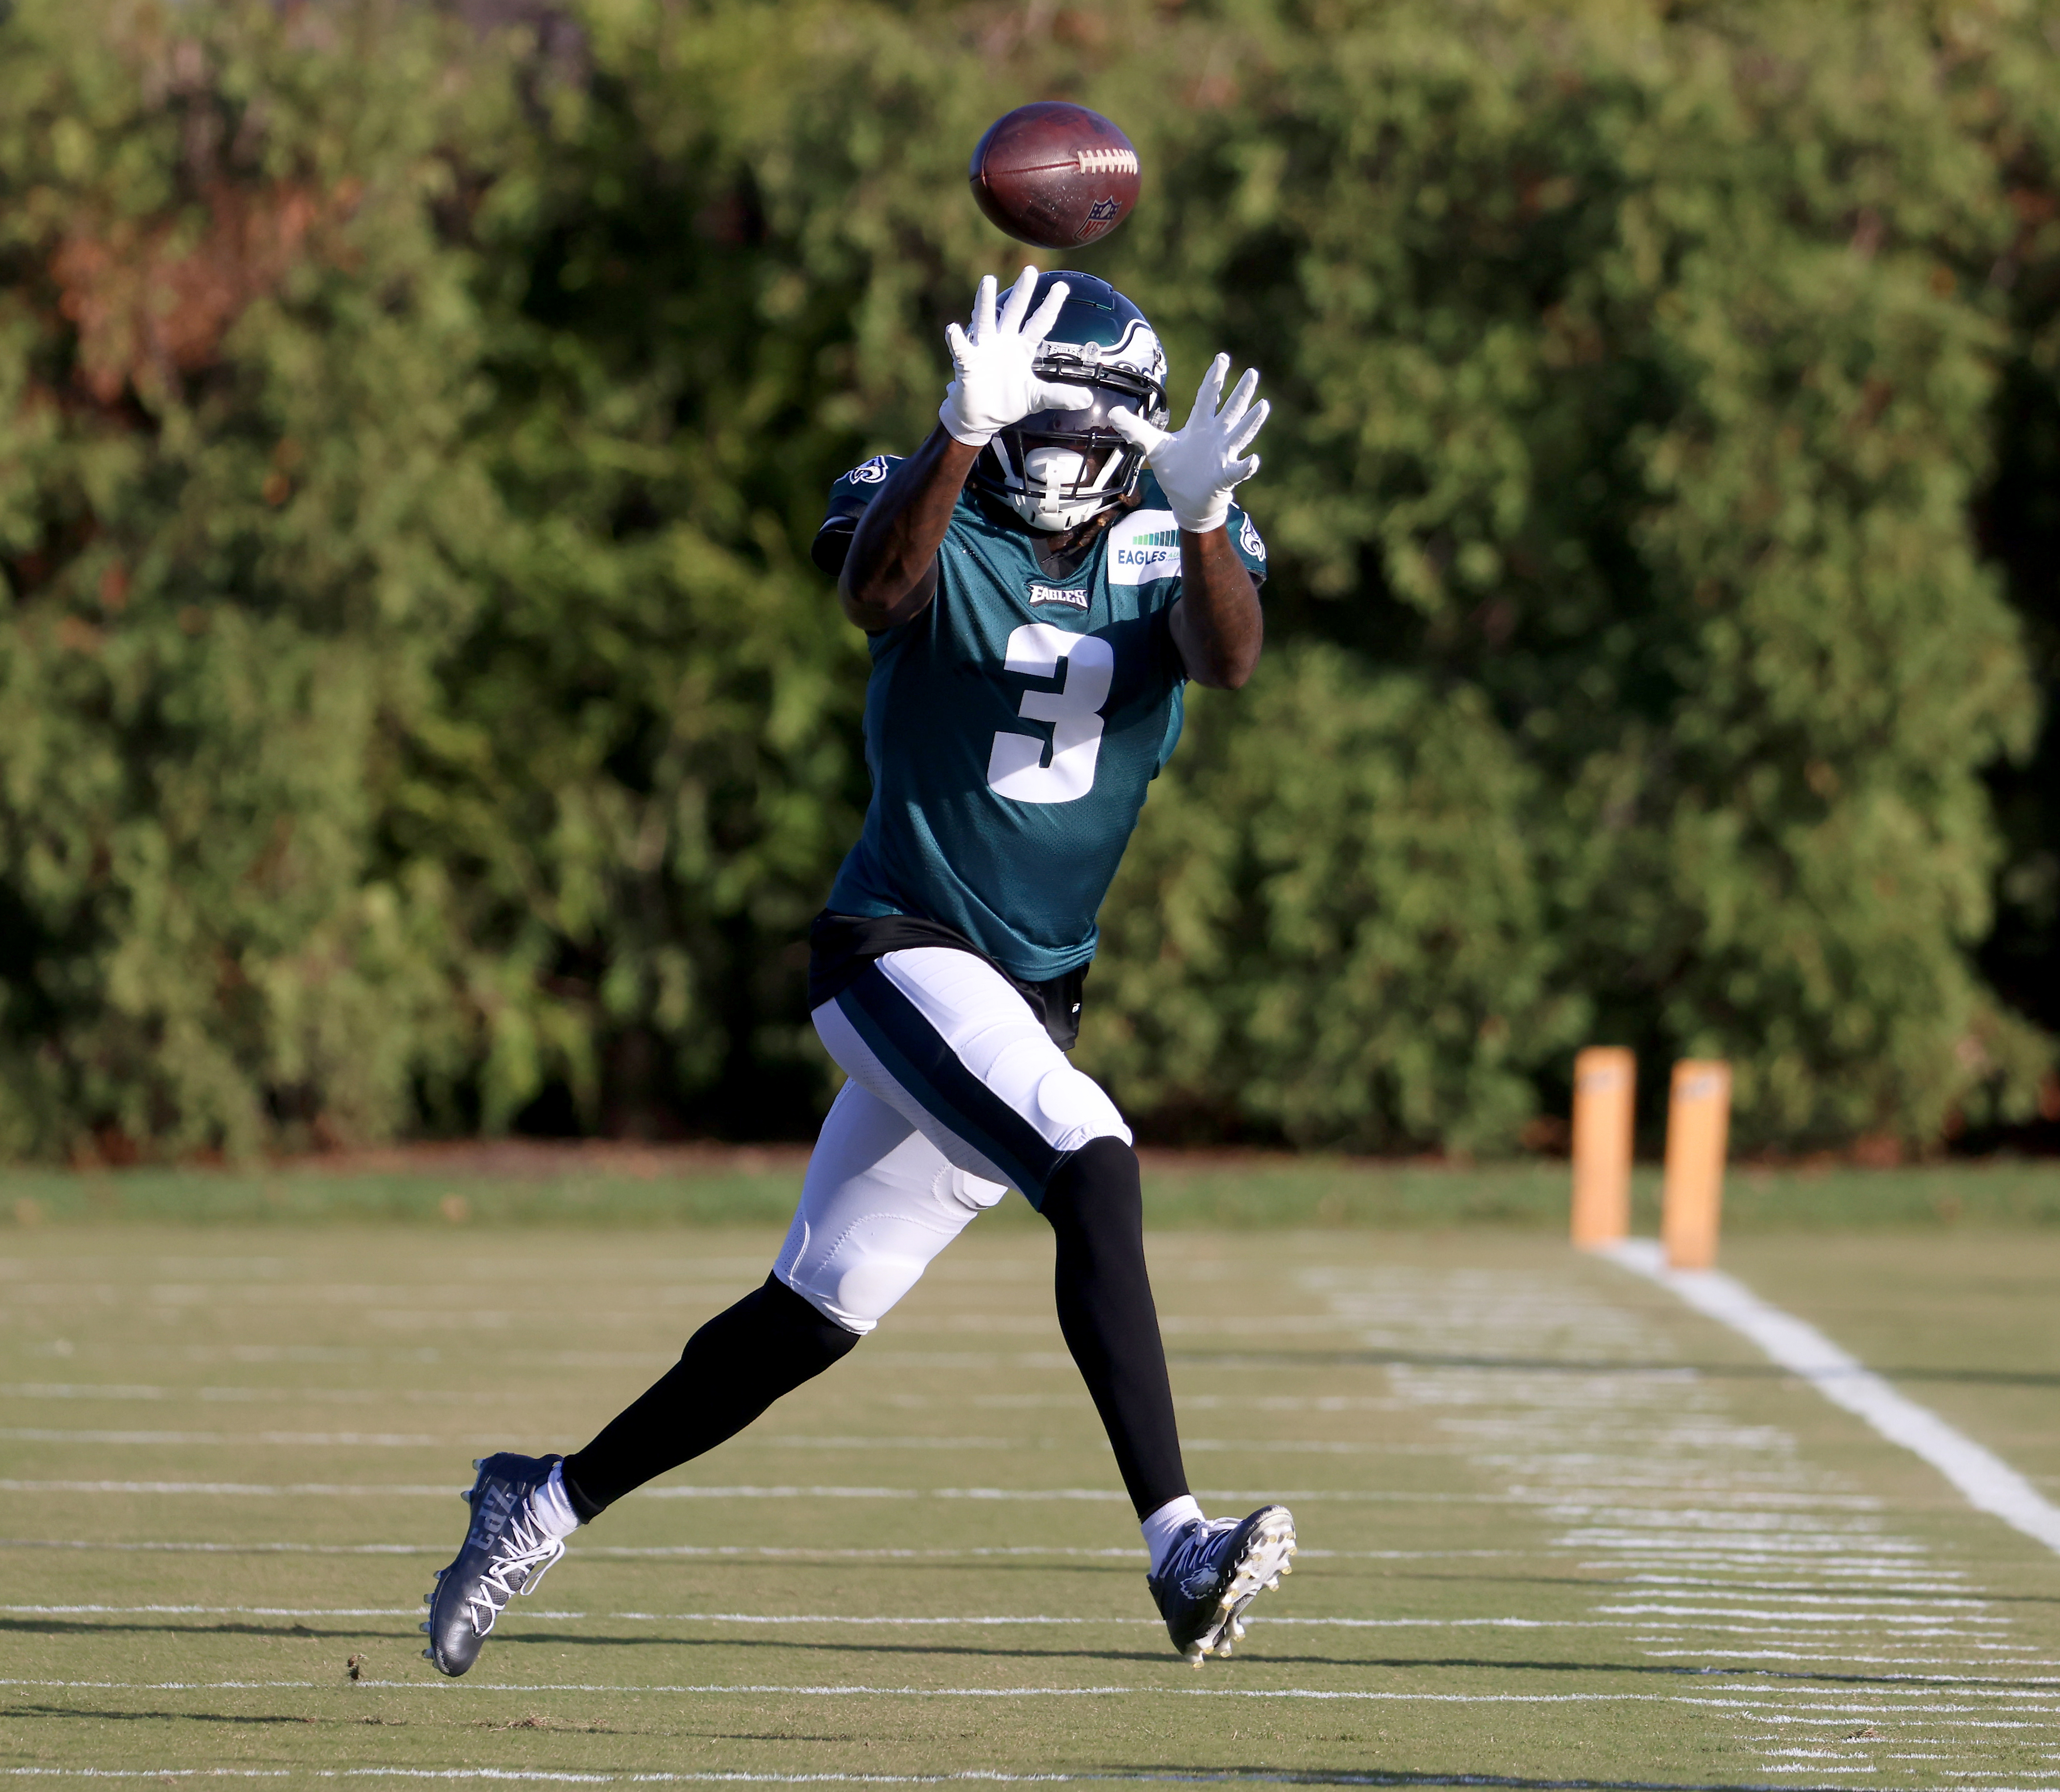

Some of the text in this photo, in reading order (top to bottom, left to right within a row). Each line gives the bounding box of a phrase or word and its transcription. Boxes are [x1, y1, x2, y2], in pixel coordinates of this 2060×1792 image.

[1118, 549, 1167, 565] EAGLES
[1029, 584, 1088, 608] EAGLES
[987, 623, 1114, 803] 3
[468, 1484, 518, 1550] ZP3
